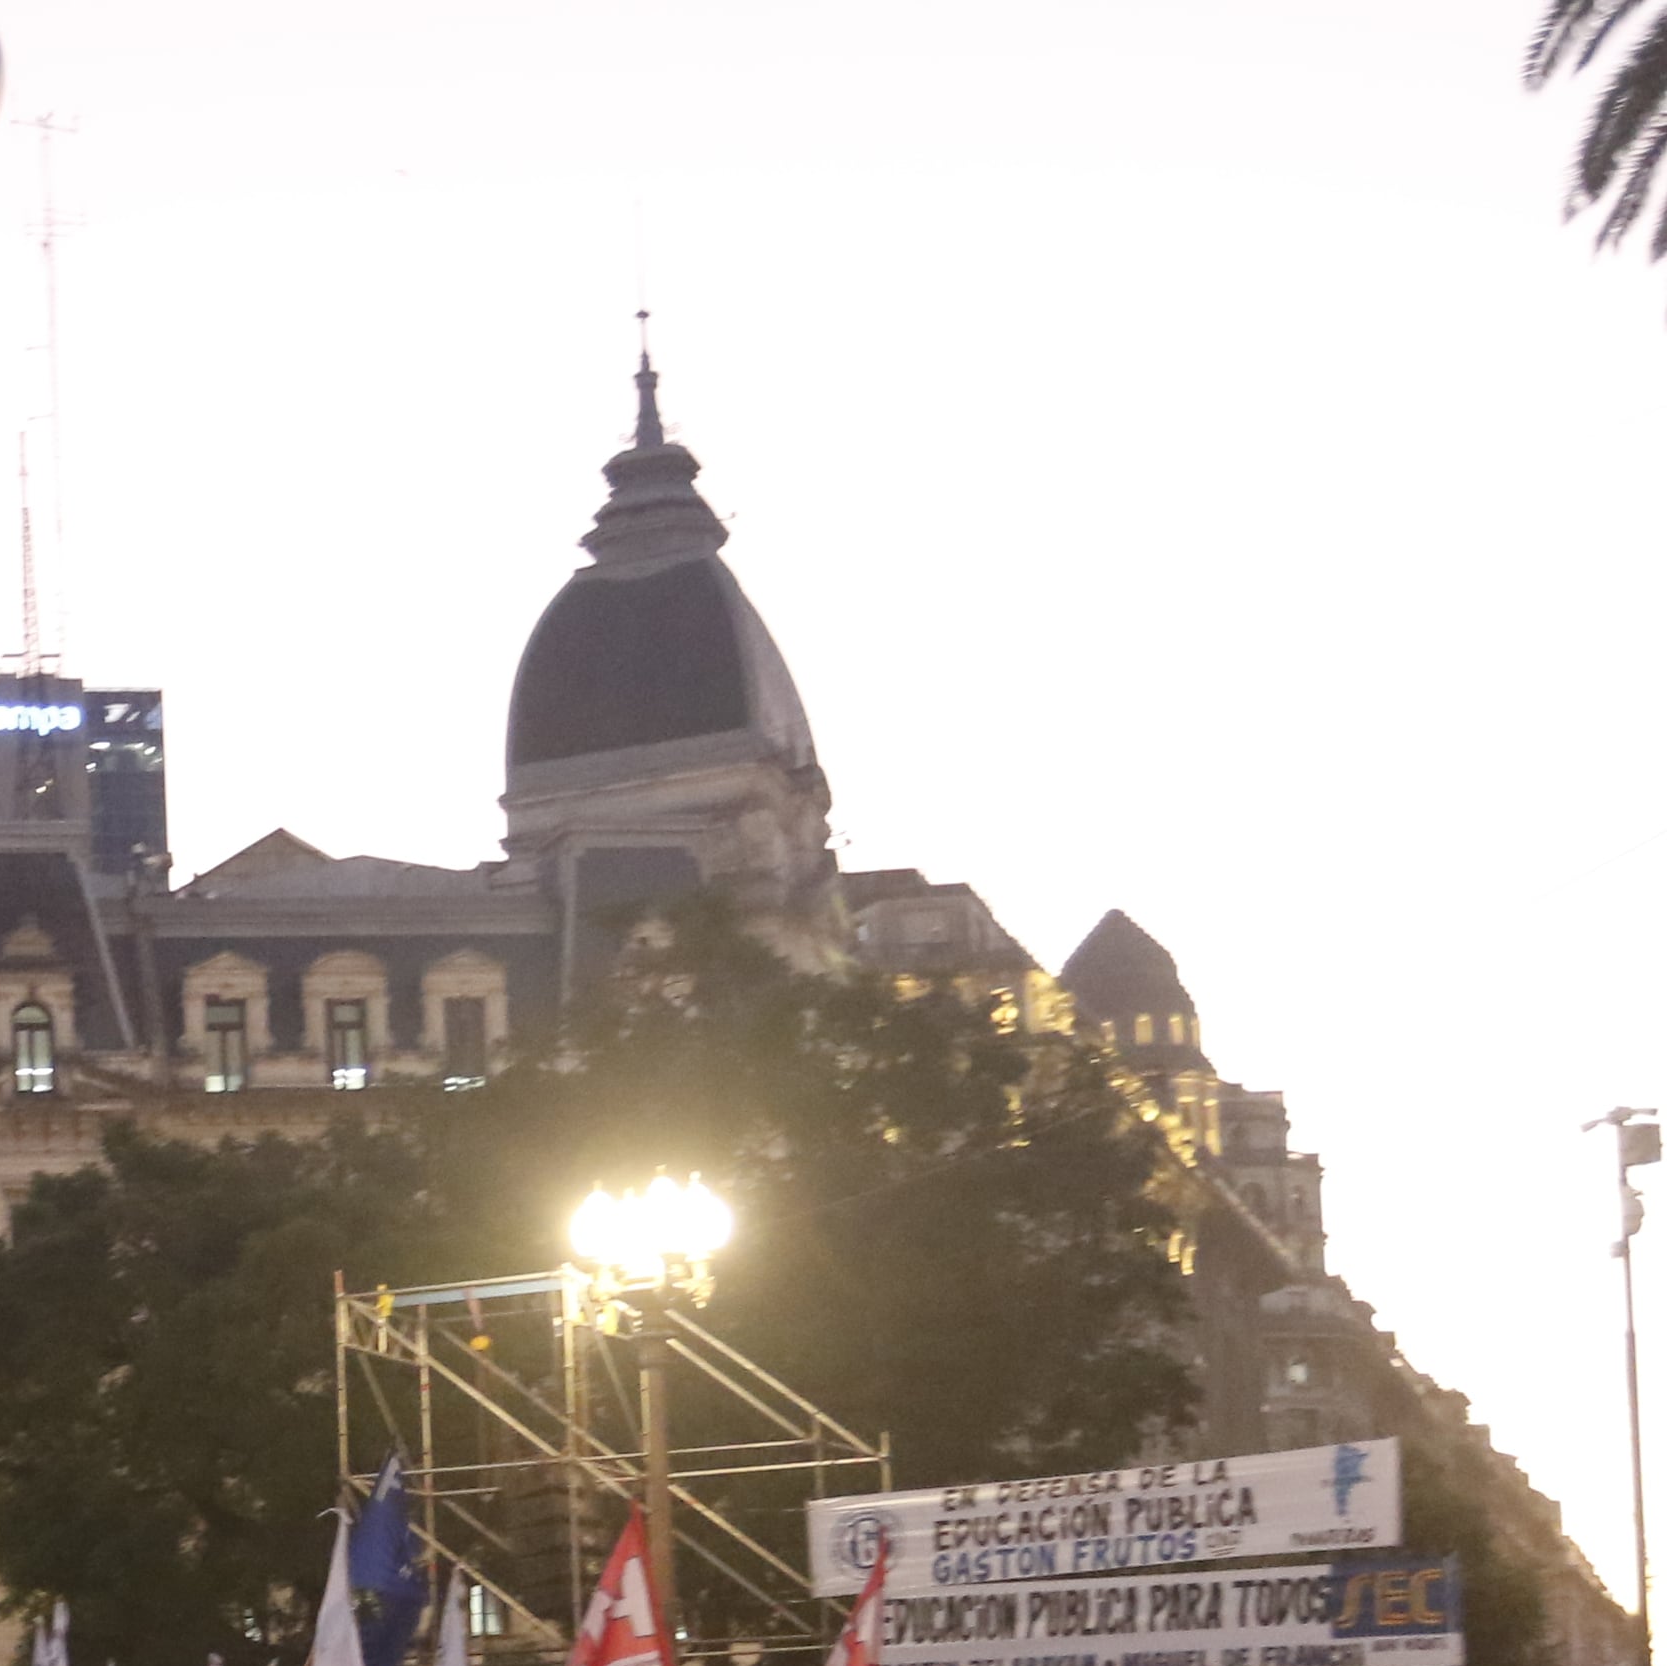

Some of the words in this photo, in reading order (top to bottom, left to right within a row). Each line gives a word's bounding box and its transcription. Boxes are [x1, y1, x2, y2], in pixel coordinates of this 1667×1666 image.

[997, 1472, 1121, 1504] DEFENSA
[1137, 1466, 1178, 1492] DE
[1194, 1460, 1229, 1486] LA
[1126, 1487, 1258, 1531] PUBLICA
[931, 1543, 1056, 1584] GASTON
[1073, 1530, 1197, 1572] FRUTOS
[1150, 1580, 1222, 1632] PARA
[1232, 1573, 1332, 1629] TODOS
[1334, 1567, 1446, 1629] SEC
